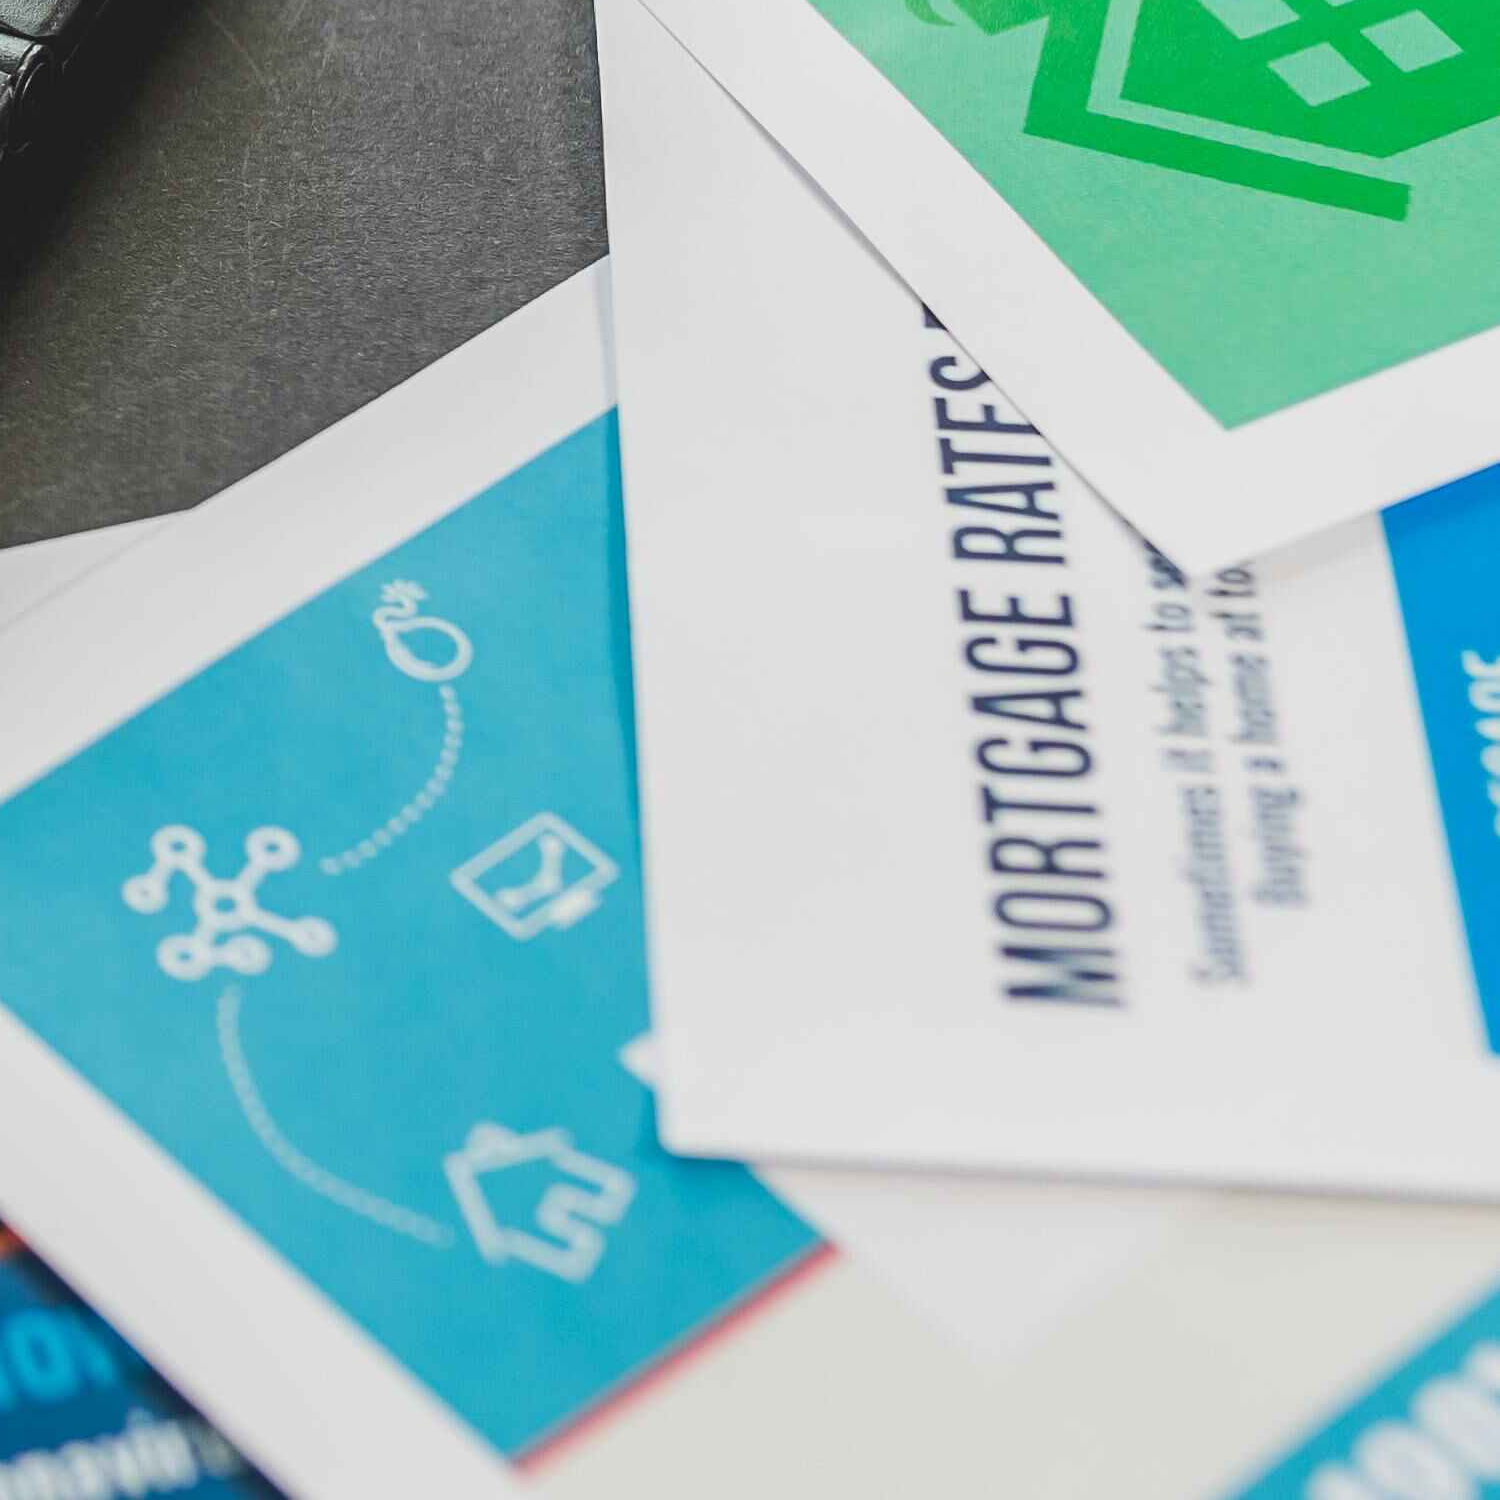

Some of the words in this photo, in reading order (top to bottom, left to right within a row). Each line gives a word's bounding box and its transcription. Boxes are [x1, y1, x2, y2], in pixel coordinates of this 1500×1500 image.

[1142, 601, 1196, 634] to
[1208, 609, 1266, 642] at
[1151, 644, 1212, 739] helps
[1226, 651, 1282, 745] home
[956, 585, 1121, 1010] MORTGAGE
[1243, 754, 1286, 775] a
[1179, 782, 1248, 986] Sometimes
[1249, 784, 1309, 908] Buying
